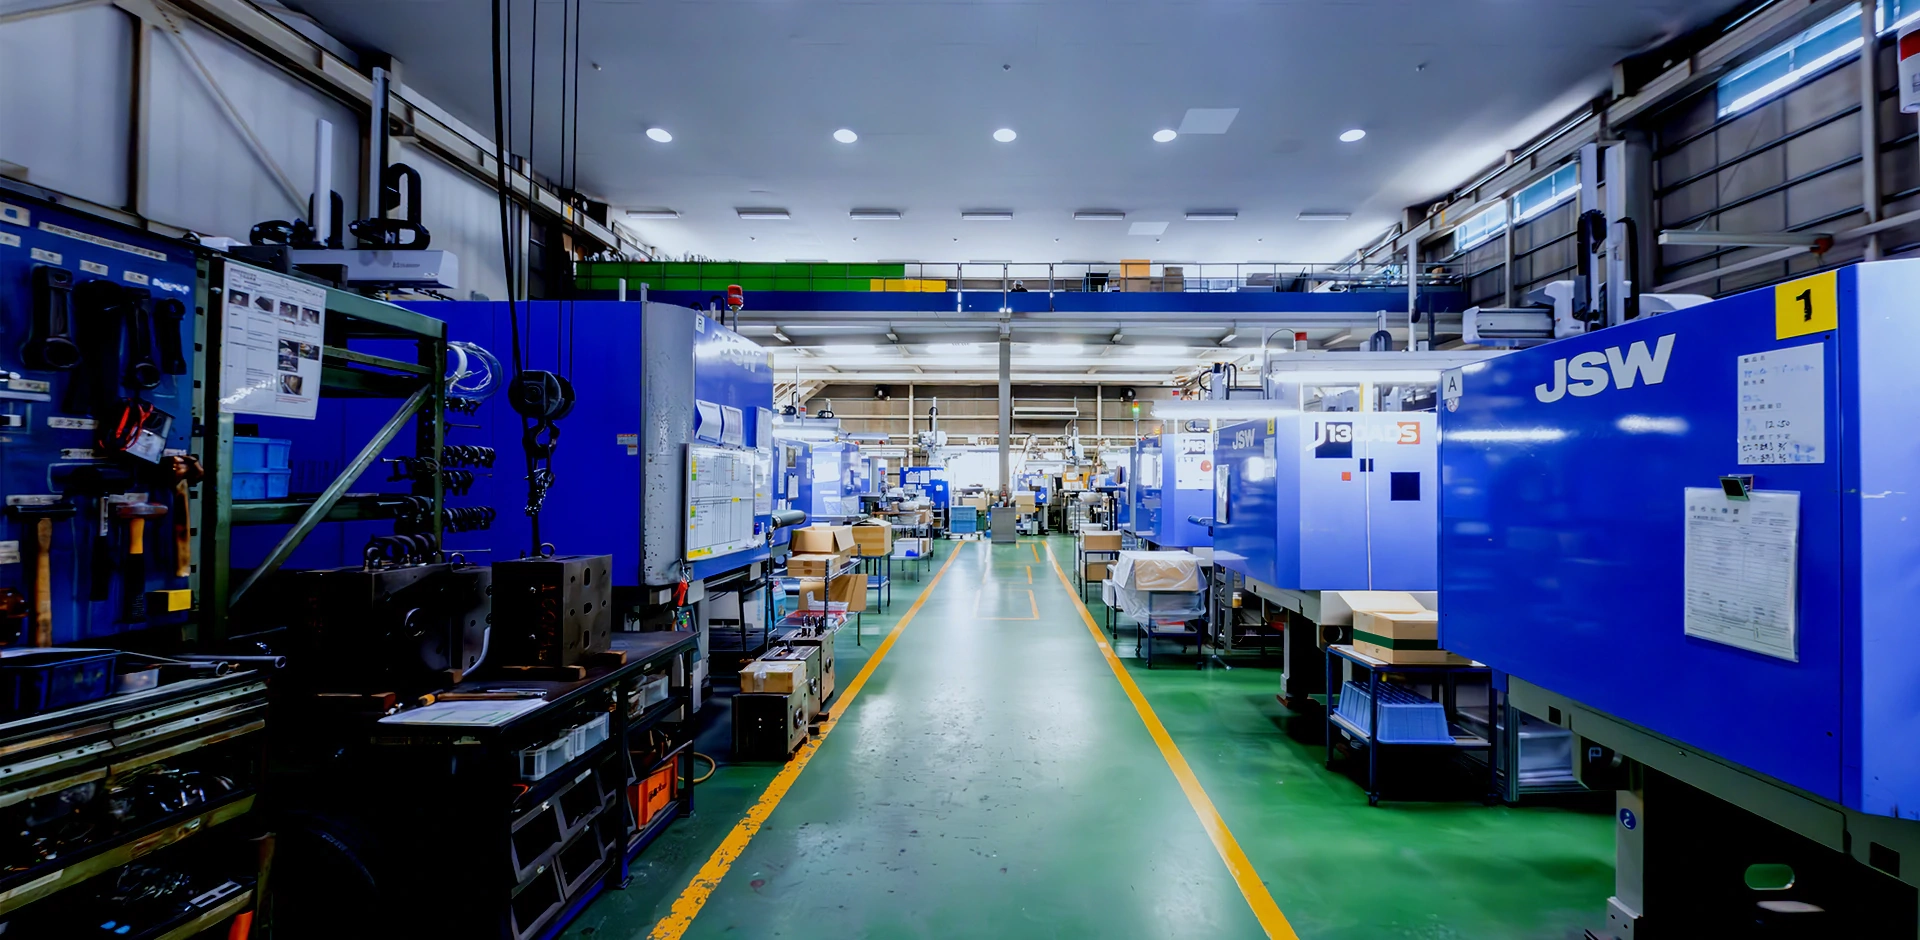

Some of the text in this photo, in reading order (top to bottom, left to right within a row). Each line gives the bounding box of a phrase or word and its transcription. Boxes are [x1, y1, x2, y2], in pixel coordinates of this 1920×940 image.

[1796, 288, 1812, 322] 1
[1448, 376, 1457, 392] A
[1535, 333, 1676, 404] JSW
[1232, 428, 1256, 450] JSW
[1304, 418, 1418, 452] J130ADS
